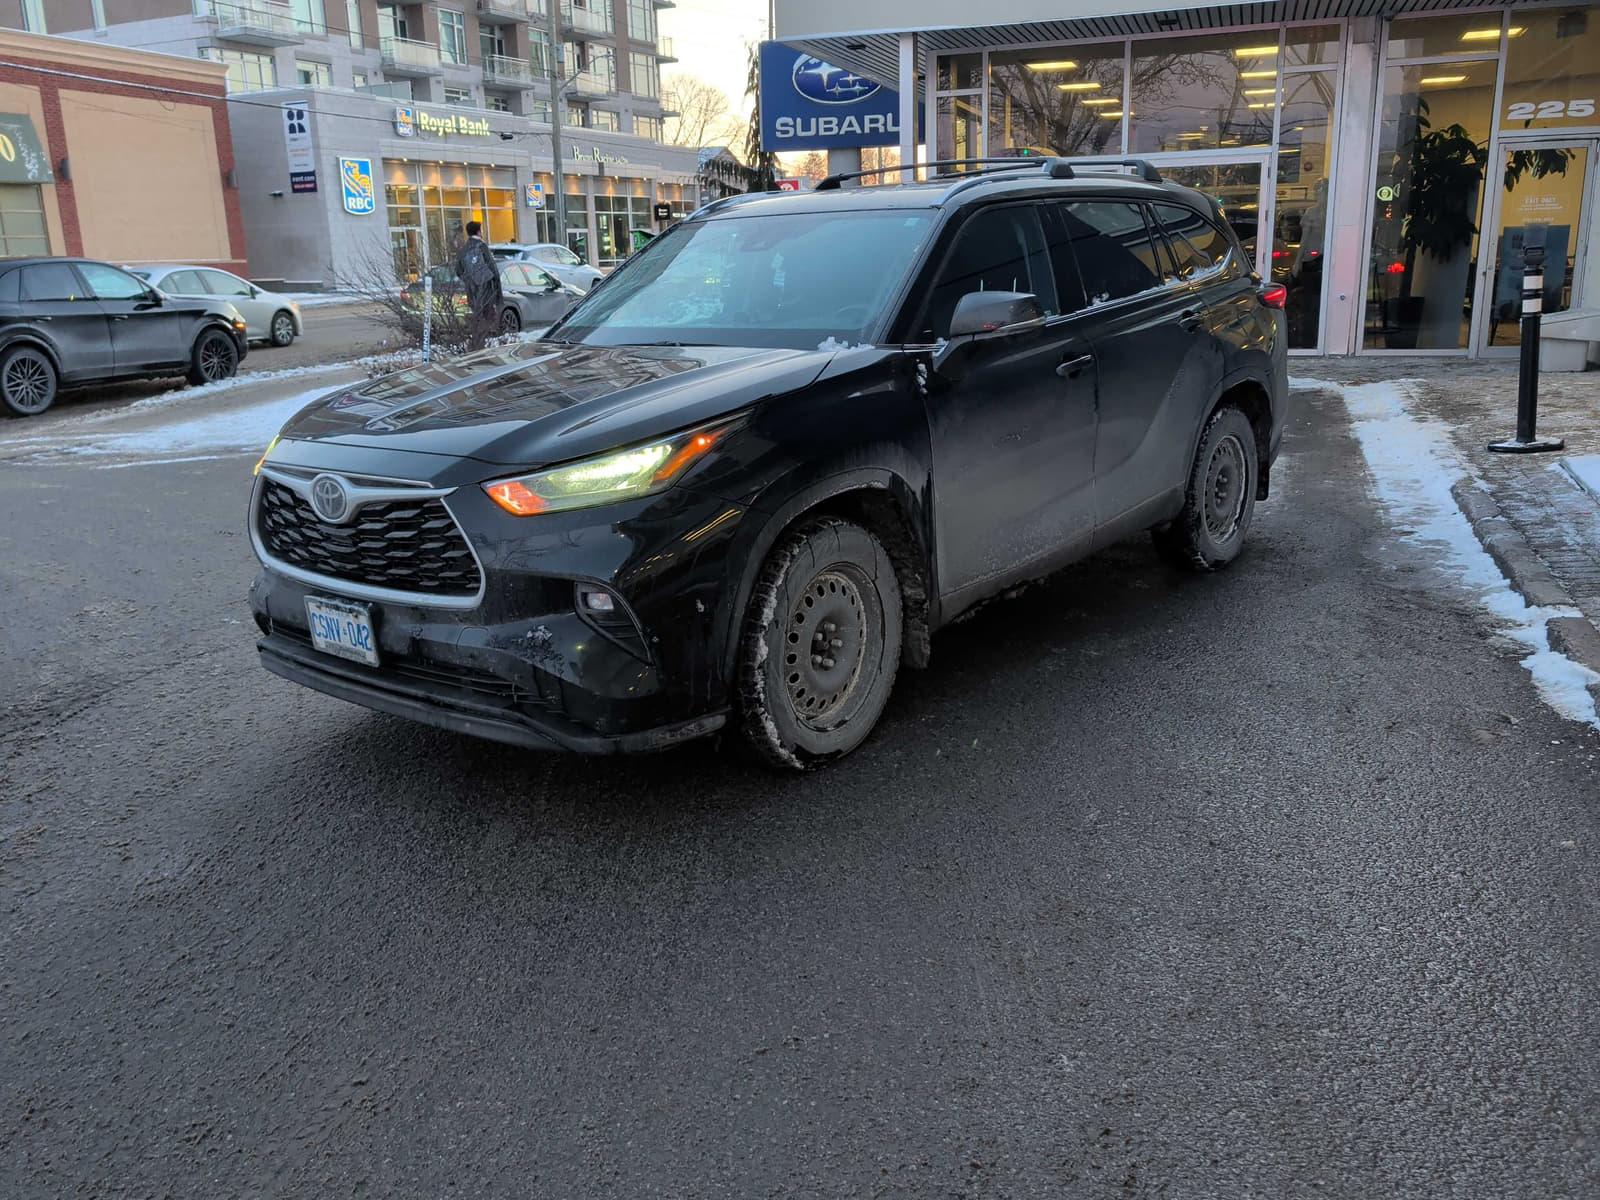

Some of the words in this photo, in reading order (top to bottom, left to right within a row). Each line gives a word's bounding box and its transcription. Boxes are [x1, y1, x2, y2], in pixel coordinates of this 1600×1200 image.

[1507, 99, 1595, 120] 225
[420, 111, 457, 136] Royal
[459, 116, 490, 136] Bank
[347, 197, 372, 210] RBC
